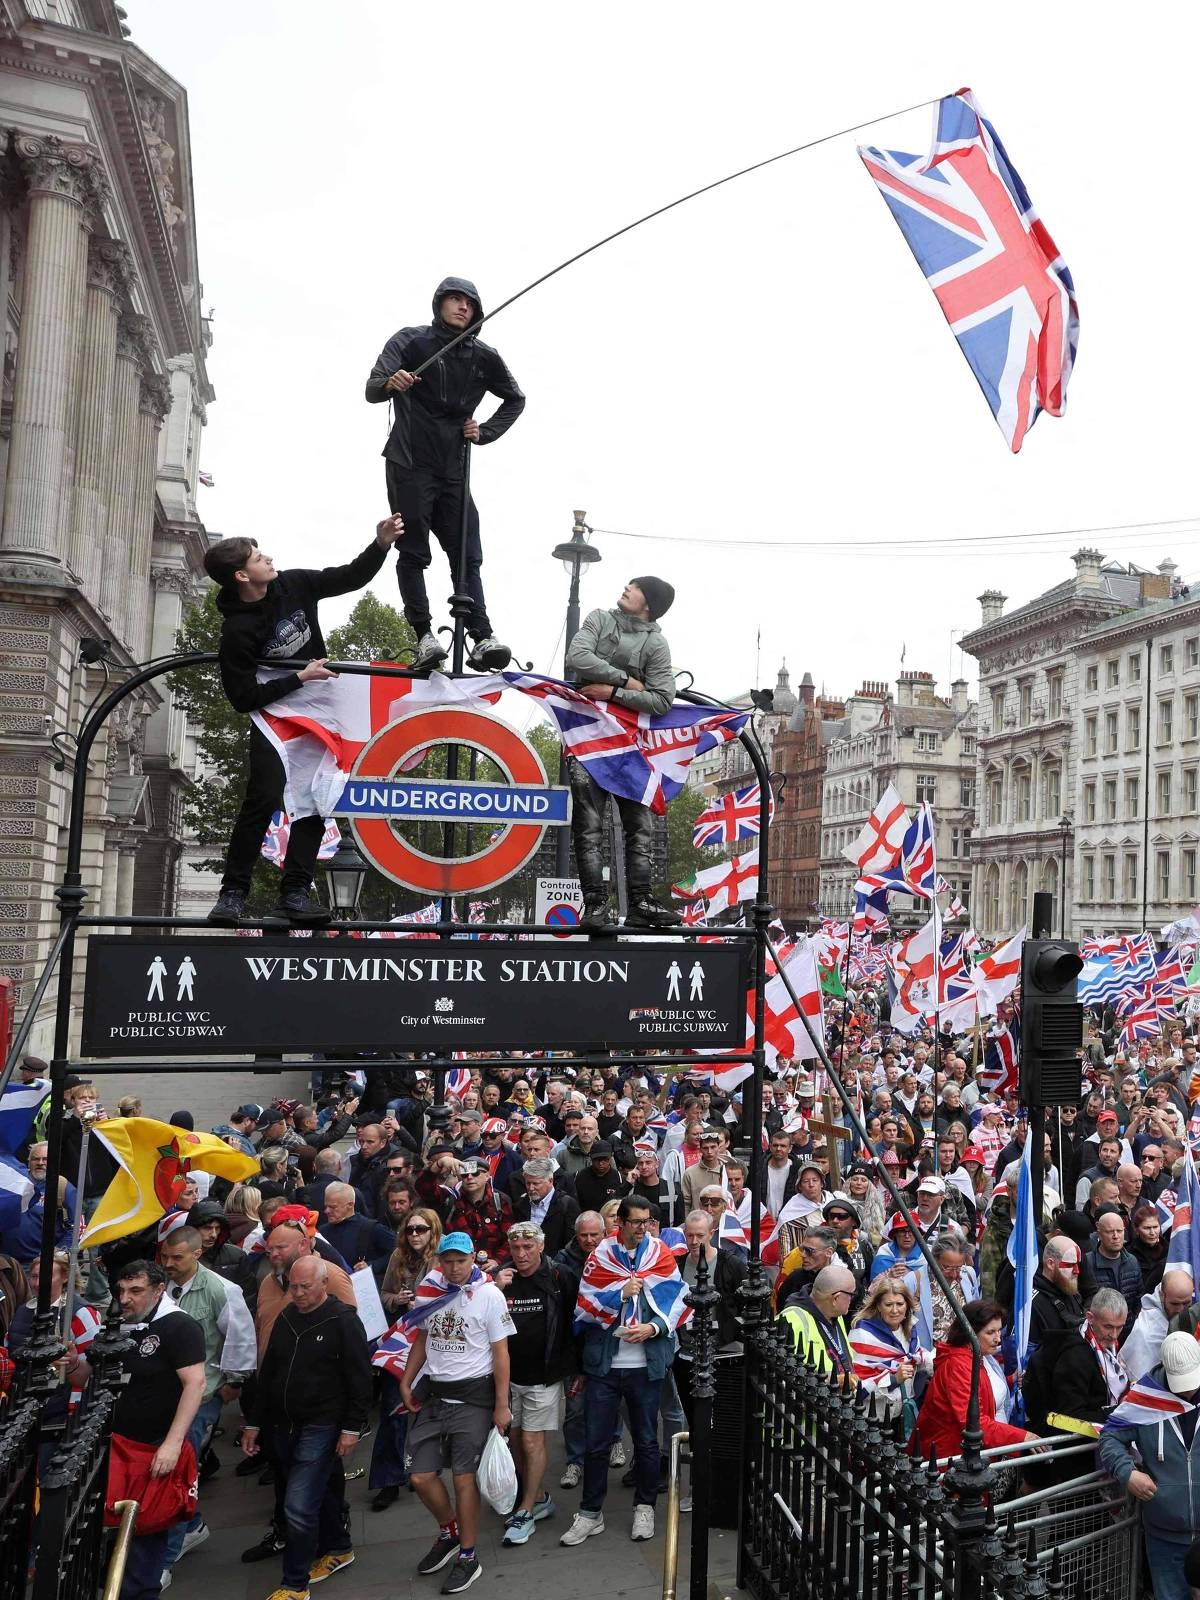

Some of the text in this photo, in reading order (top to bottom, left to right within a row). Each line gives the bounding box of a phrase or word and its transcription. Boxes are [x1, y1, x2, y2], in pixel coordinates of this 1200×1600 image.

[349, 787, 550, 813] UNDERGROUND
[540, 881, 582, 890] Controlle
[546, 891, 580, 902] ZONE
[245, 957, 630, 983] WESTMINSTER STATION
[128, 1011, 210, 1023] PUBLIC WC
[400, 1014, 486, 1027] City of Westminster
[697, 1010, 717, 1020] WC
[110, 1025, 227, 1038] PUBLIC SUBWAY
[639, 1022, 730, 1033] PUBLIC SUBWAY
[430, 1341, 465, 1352] KINGDOM
